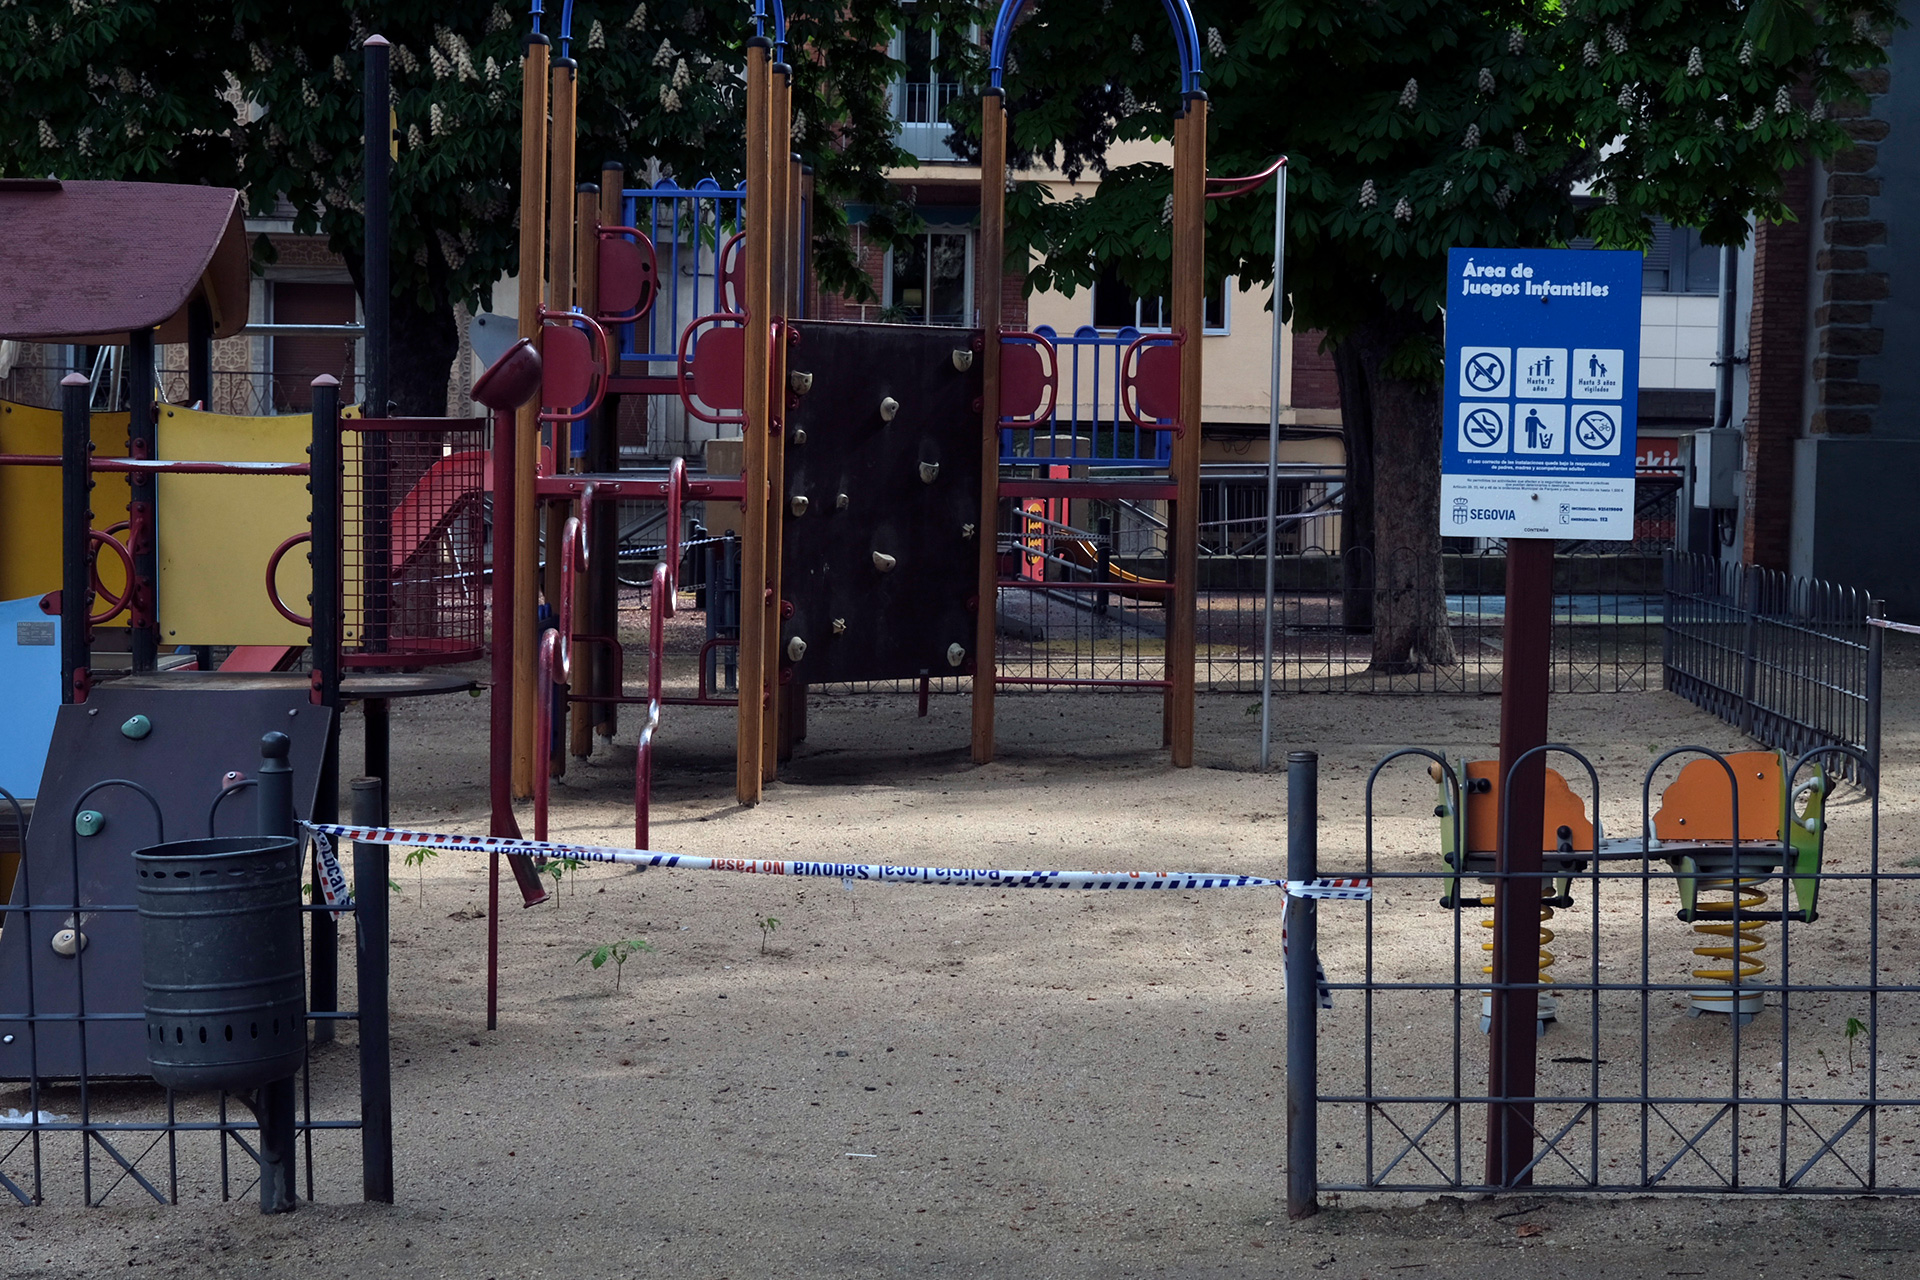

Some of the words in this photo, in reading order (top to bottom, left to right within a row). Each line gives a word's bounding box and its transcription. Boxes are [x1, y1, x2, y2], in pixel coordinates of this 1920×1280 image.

[1462, 257, 1506, 278] Área
[1511, 263, 1534, 278] de
[1462, 280, 1520, 297] Juegos
[1525, 280, 1609, 297] Infantiles
[1470, 508, 1516, 521] SEGOVIA
[709, 857, 757, 873] Pasar
[762, 860, 785, 875] No
